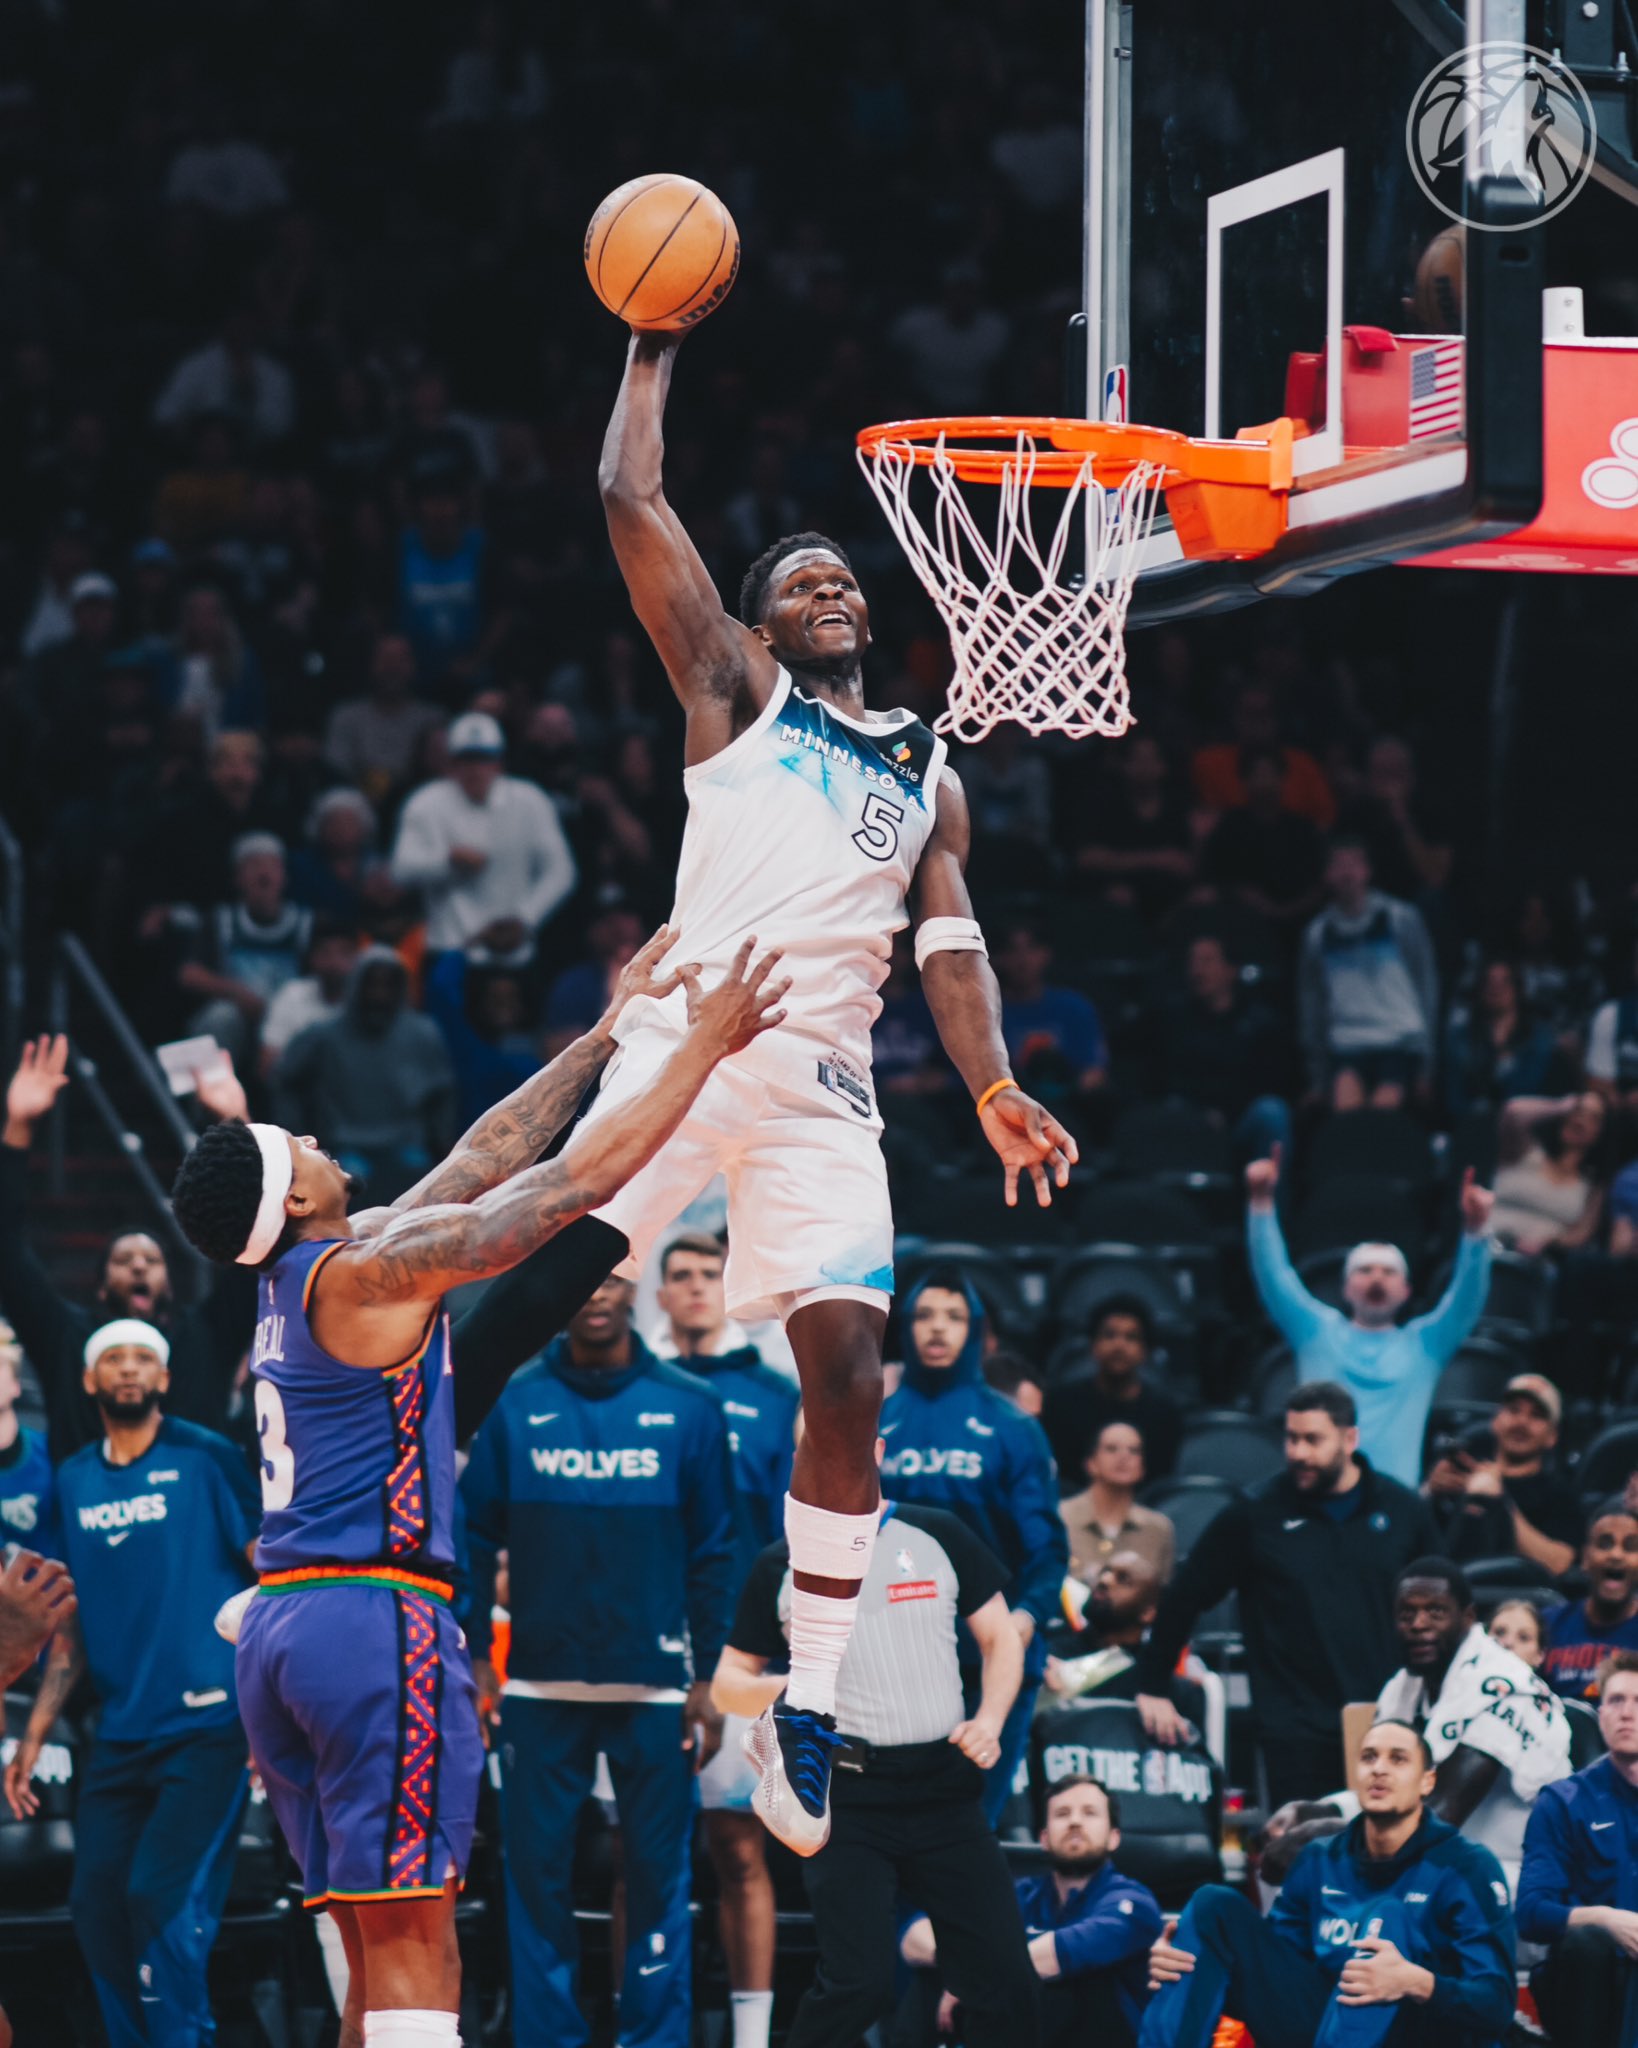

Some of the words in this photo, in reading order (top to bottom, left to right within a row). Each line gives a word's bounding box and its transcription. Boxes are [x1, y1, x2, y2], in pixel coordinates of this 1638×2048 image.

[851, 792, 905, 861] 5
[253, 1379, 295, 1512] 3
[530, 1447, 660, 1479] WOLVES
[77, 1493, 168, 1531] WOLVES
[850, 1536, 868, 1551] 5
